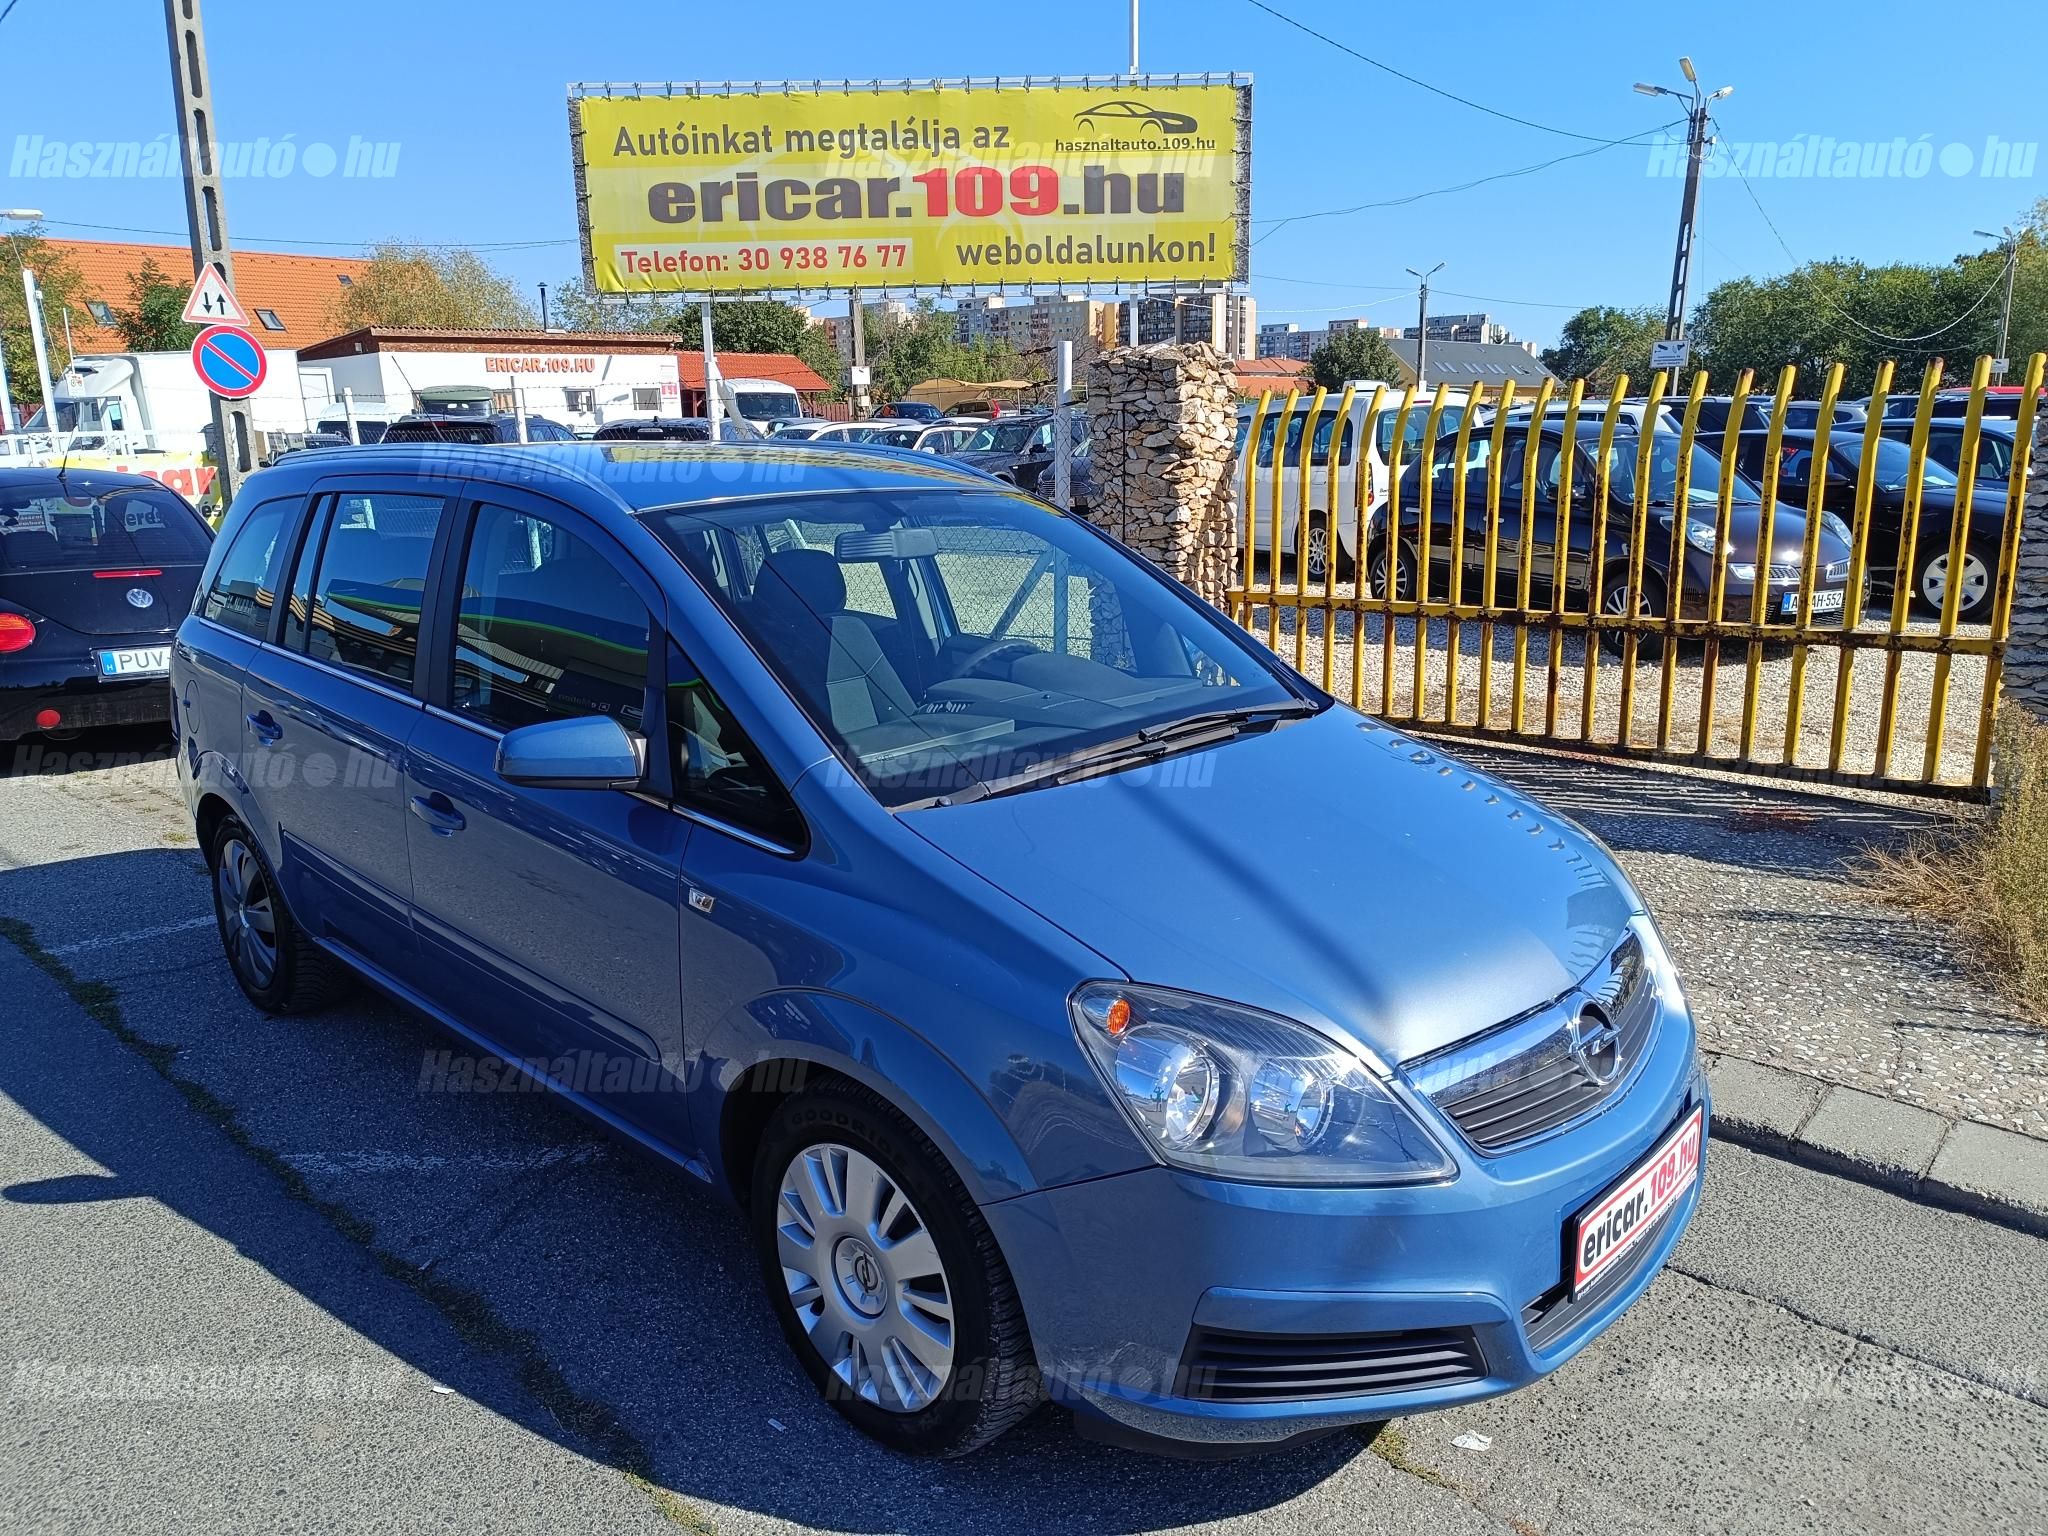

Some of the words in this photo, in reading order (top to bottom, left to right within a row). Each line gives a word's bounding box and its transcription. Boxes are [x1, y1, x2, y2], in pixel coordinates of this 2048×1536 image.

[613, 121, 773, 156] Autóinkat
[785, 115, 961, 159] megtalálja
[973, 126, 1010, 149] az
[1055, 137, 1216, 151] hasznaltauto.109.hu
[647, 165, 1185, 223] ericar.109.hu
[621, 251, 729, 273] Telefon:
[738, 248, 770, 271] 30
[780, 246, 828, 269] 938
[838, 245, 867, 268] 76
[877, 244, 906, 267] 77
[956, 232, 1216, 266] weboldalunkon!
[485, 357, 595, 373] ERICAR.109.HU
[1583, 1129, 1697, 1268] ericar.109.hu
